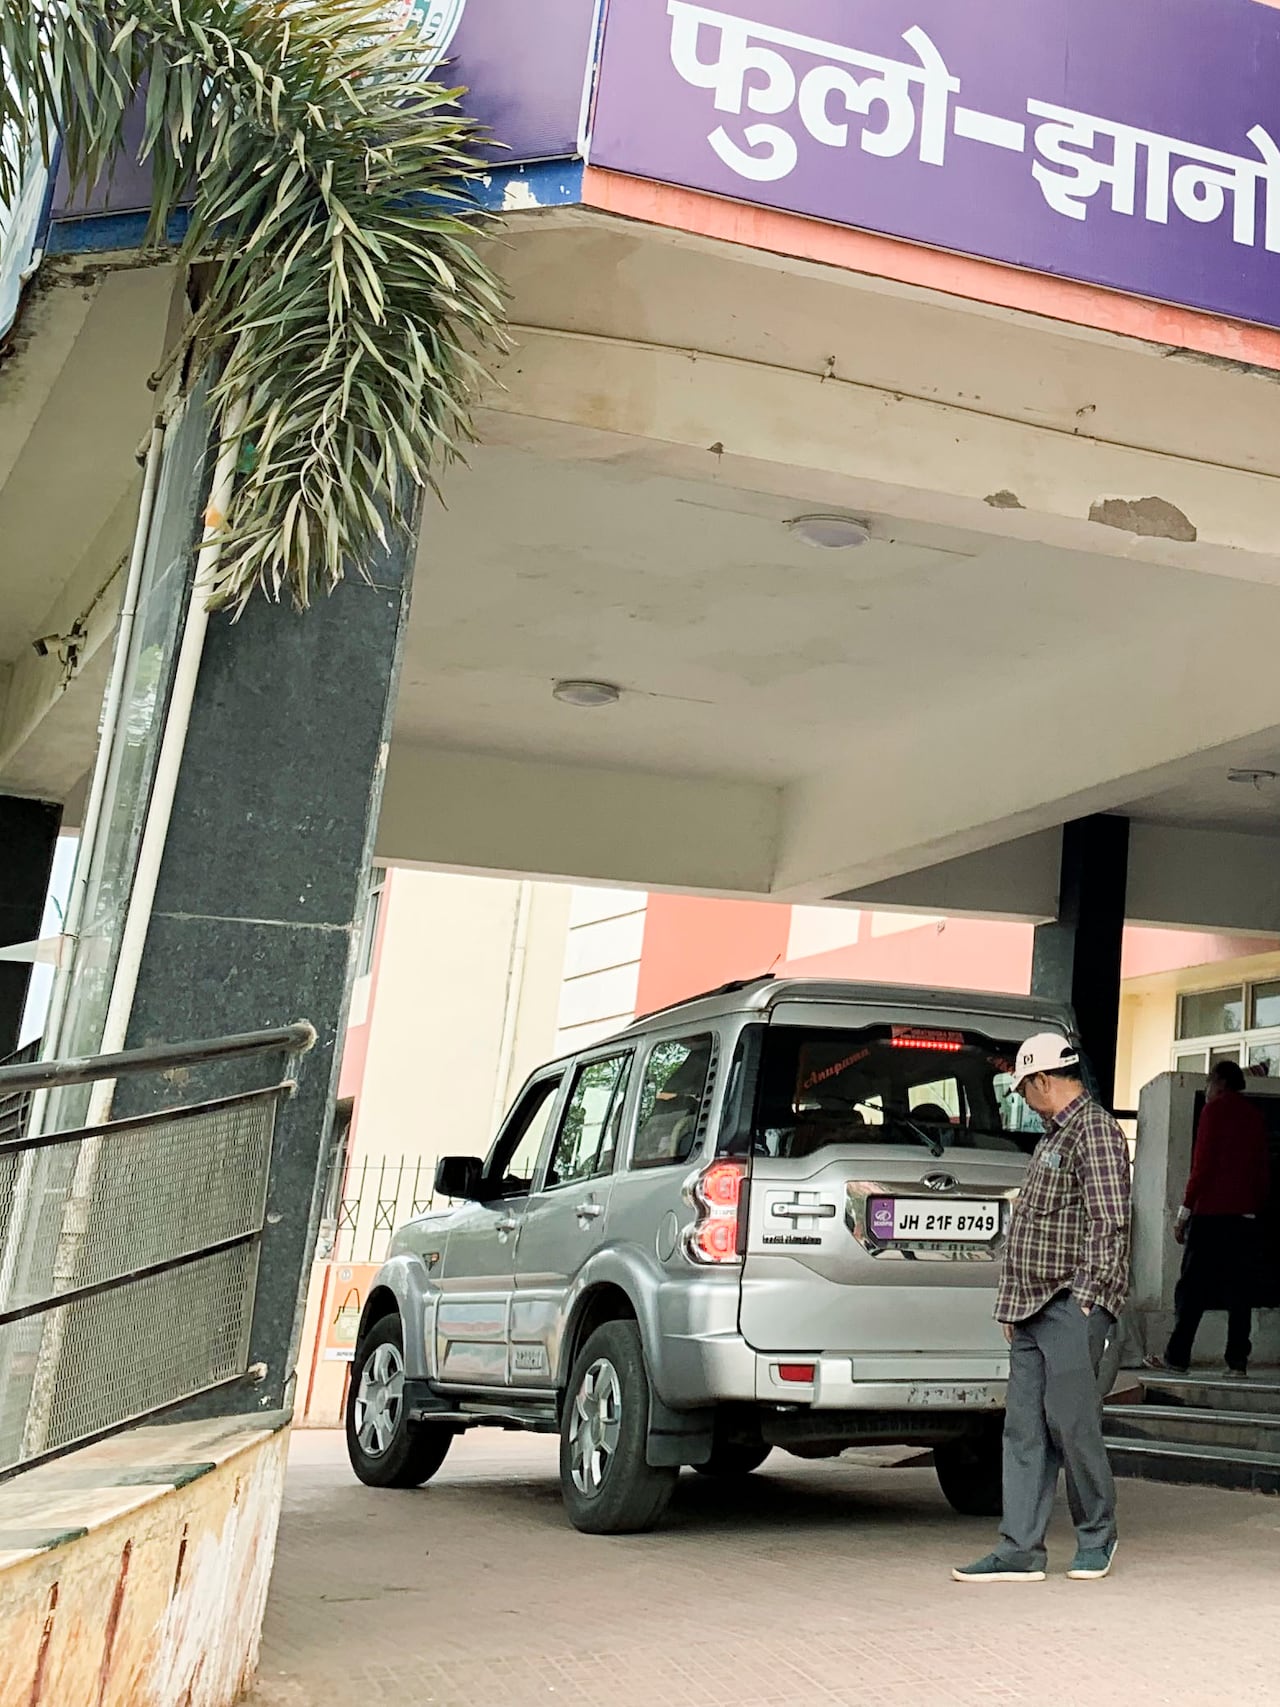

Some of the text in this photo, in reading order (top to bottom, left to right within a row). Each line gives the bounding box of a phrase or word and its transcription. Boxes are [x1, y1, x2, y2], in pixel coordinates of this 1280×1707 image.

[899, 1215, 995, 1232] JH 21F 8749
